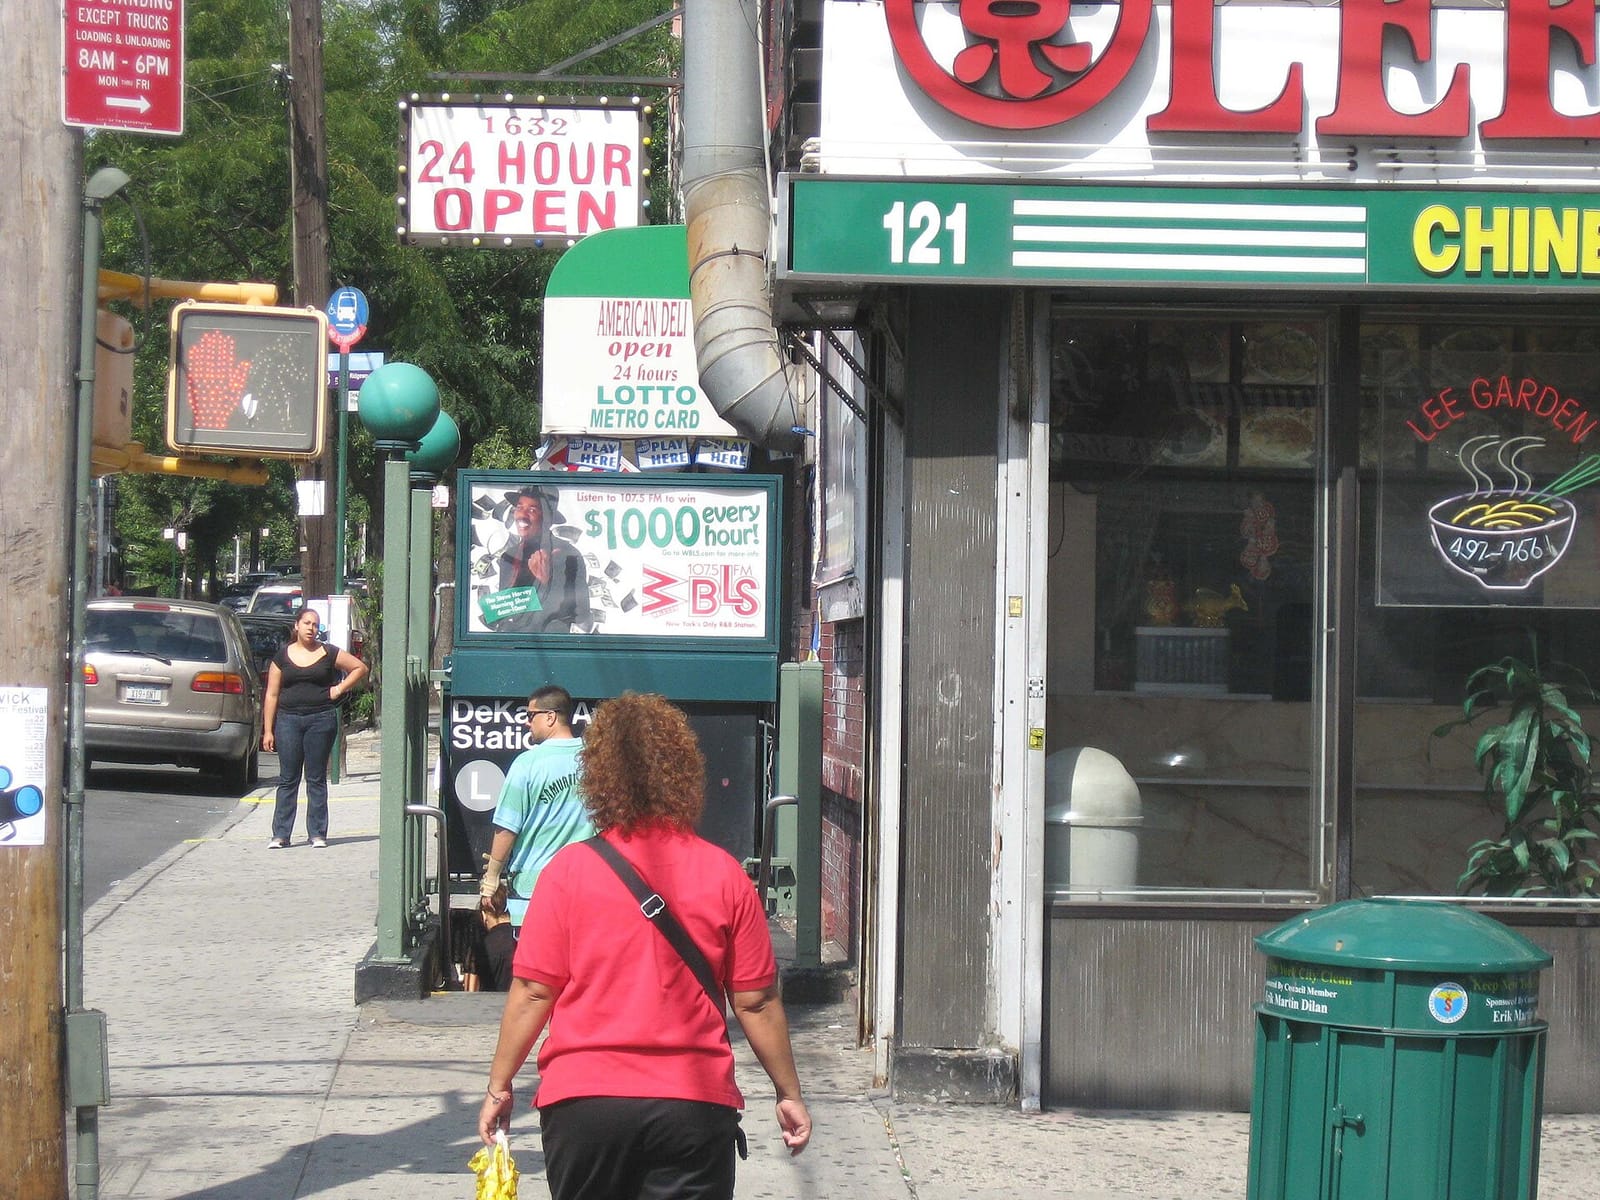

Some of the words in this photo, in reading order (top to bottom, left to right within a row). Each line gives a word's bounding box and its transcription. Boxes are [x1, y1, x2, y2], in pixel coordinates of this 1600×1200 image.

[78, 7, 121, 26] EXCEPT
[127, 12, 169, 31] TRUCKS
[76, 29, 112, 44] LOADING
[115, 34, 122, 45] &
[125, 34, 171, 50] UNLOADING
[78, 48, 115, 70] 8AM
[135, 54, 169, 77] 6PM
[98, 75, 119, 88] MON
[135, 79, 151, 91] FRI
[485, 115, 568, 136] 1632
[417, 139, 475, 184] 24
[498, 140, 632, 187] HOUR
[433, 187, 616, 234] OPEN
[882, 200, 968, 266] 121
[597, 300, 657, 337] AMERICAN
[660, 301, 687, 338] DELI
[608, 341, 672, 362] open
[613, 365, 632, 381] 24
[638, 364, 678, 382] hours
[597, 385, 697, 406] LOTTO
[590, 409, 649, 429] METRO
[654, 409, 700, 430] CARD
[1406, 387, 1465, 442] LEE
[1471, 375, 1598, 443] GARDEN
[583, 441, 617, 454] PLAY
[651, 439, 683, 452] PLAY
[580, 453, 617, 468] HERE
[651, 451, 688, 465] HERE
[711, 451, 747, 466] HERE
[577, 492, 603, 503] Listen
[607, 493, 616, 503] to
[621, 493, 646, 503] 107.5
[649, 493, 662, 503] FM
[665, 495, 675, 504] to
[678, 494, 697, 504] win
[702, 505, 761, 524] every
[584, 505, 701, 550] $1000
[704, 524, 760, 547] hour!
[733, 563, 753, 576] FM
[452, 700, 528, 723] DeKa
[572, 702, 595, 725] A
[470, 771, 491, 800] L
[1321, 970, 1353, 986] Clean
[1284, 982, 1306, 994] Council
[1307, 985, 1338, 999] Member
[1275, 992, 1300, 1010] Martin
[1301, 997, 1329, 1014] Dilan
[1493, 1010, 1513, 1023] Erik
